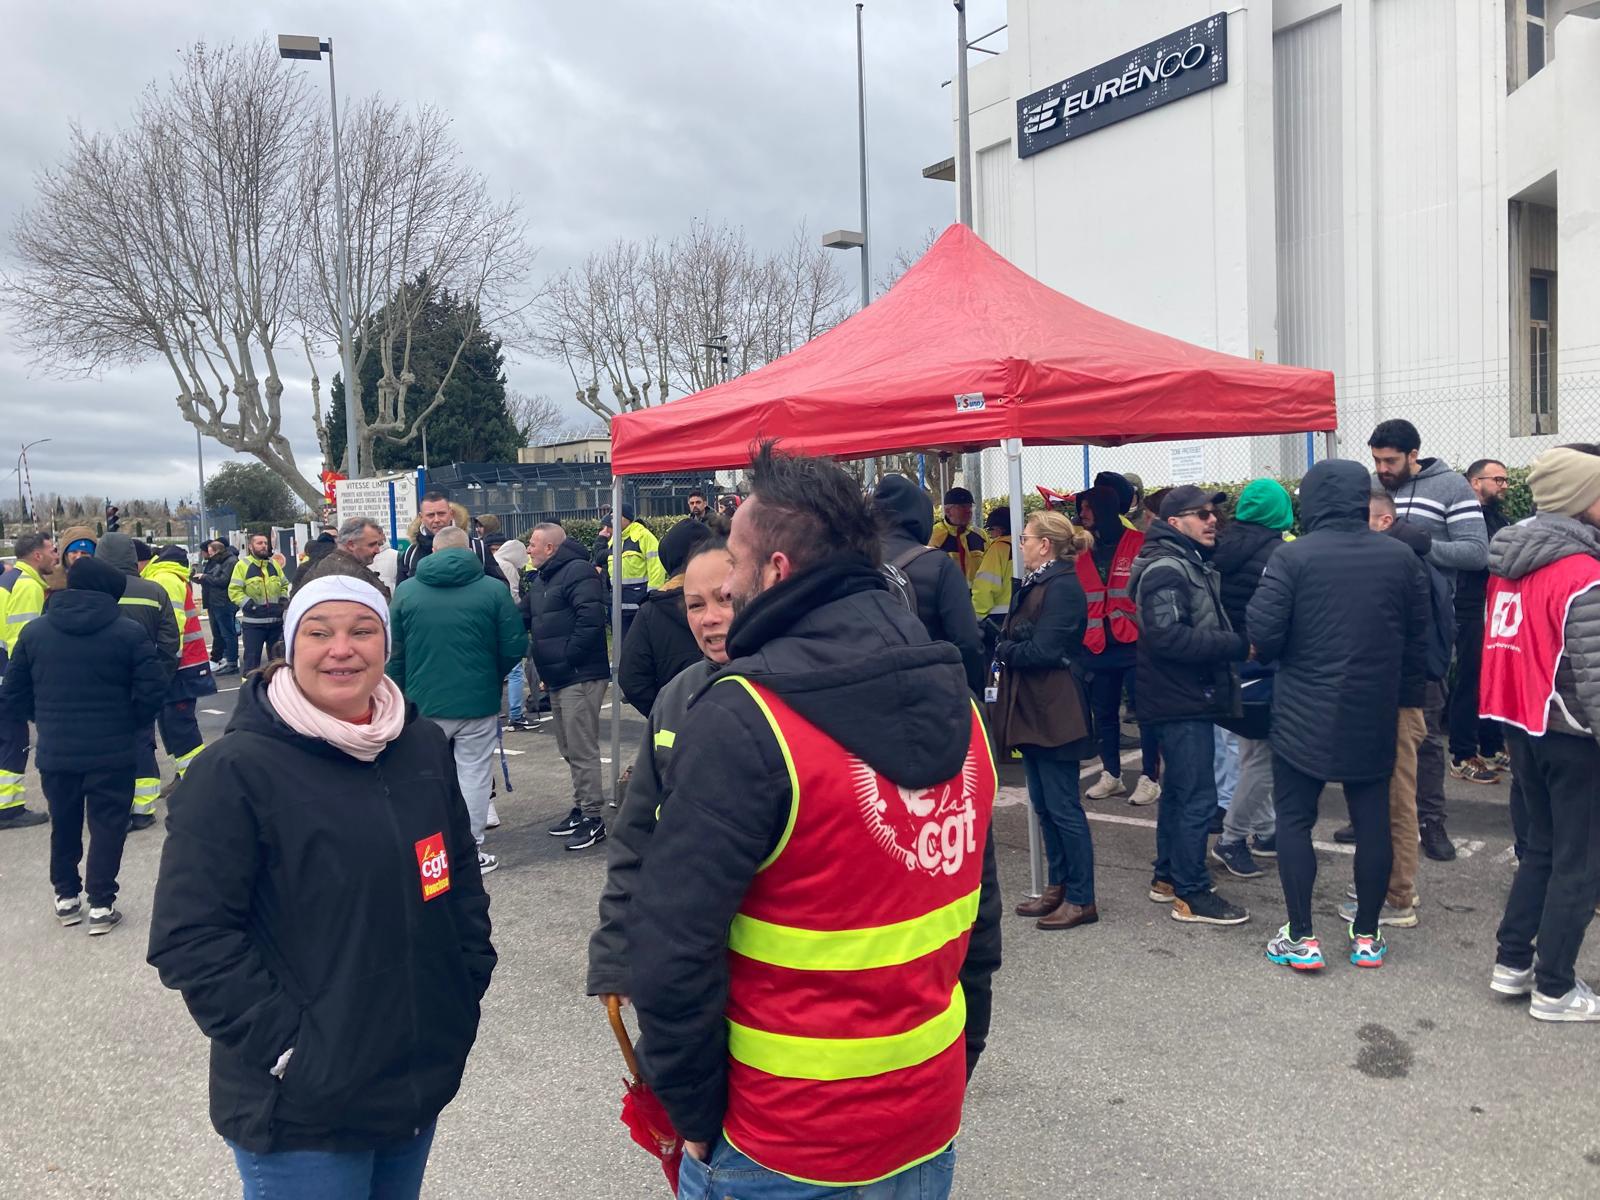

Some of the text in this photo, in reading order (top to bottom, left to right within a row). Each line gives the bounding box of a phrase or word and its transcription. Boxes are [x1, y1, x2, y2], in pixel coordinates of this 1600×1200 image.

[1063, 43, 1205, 118] EURENCO
[422, 849, 448, 878] cgt
[917, 797, 977, 876] cgt
